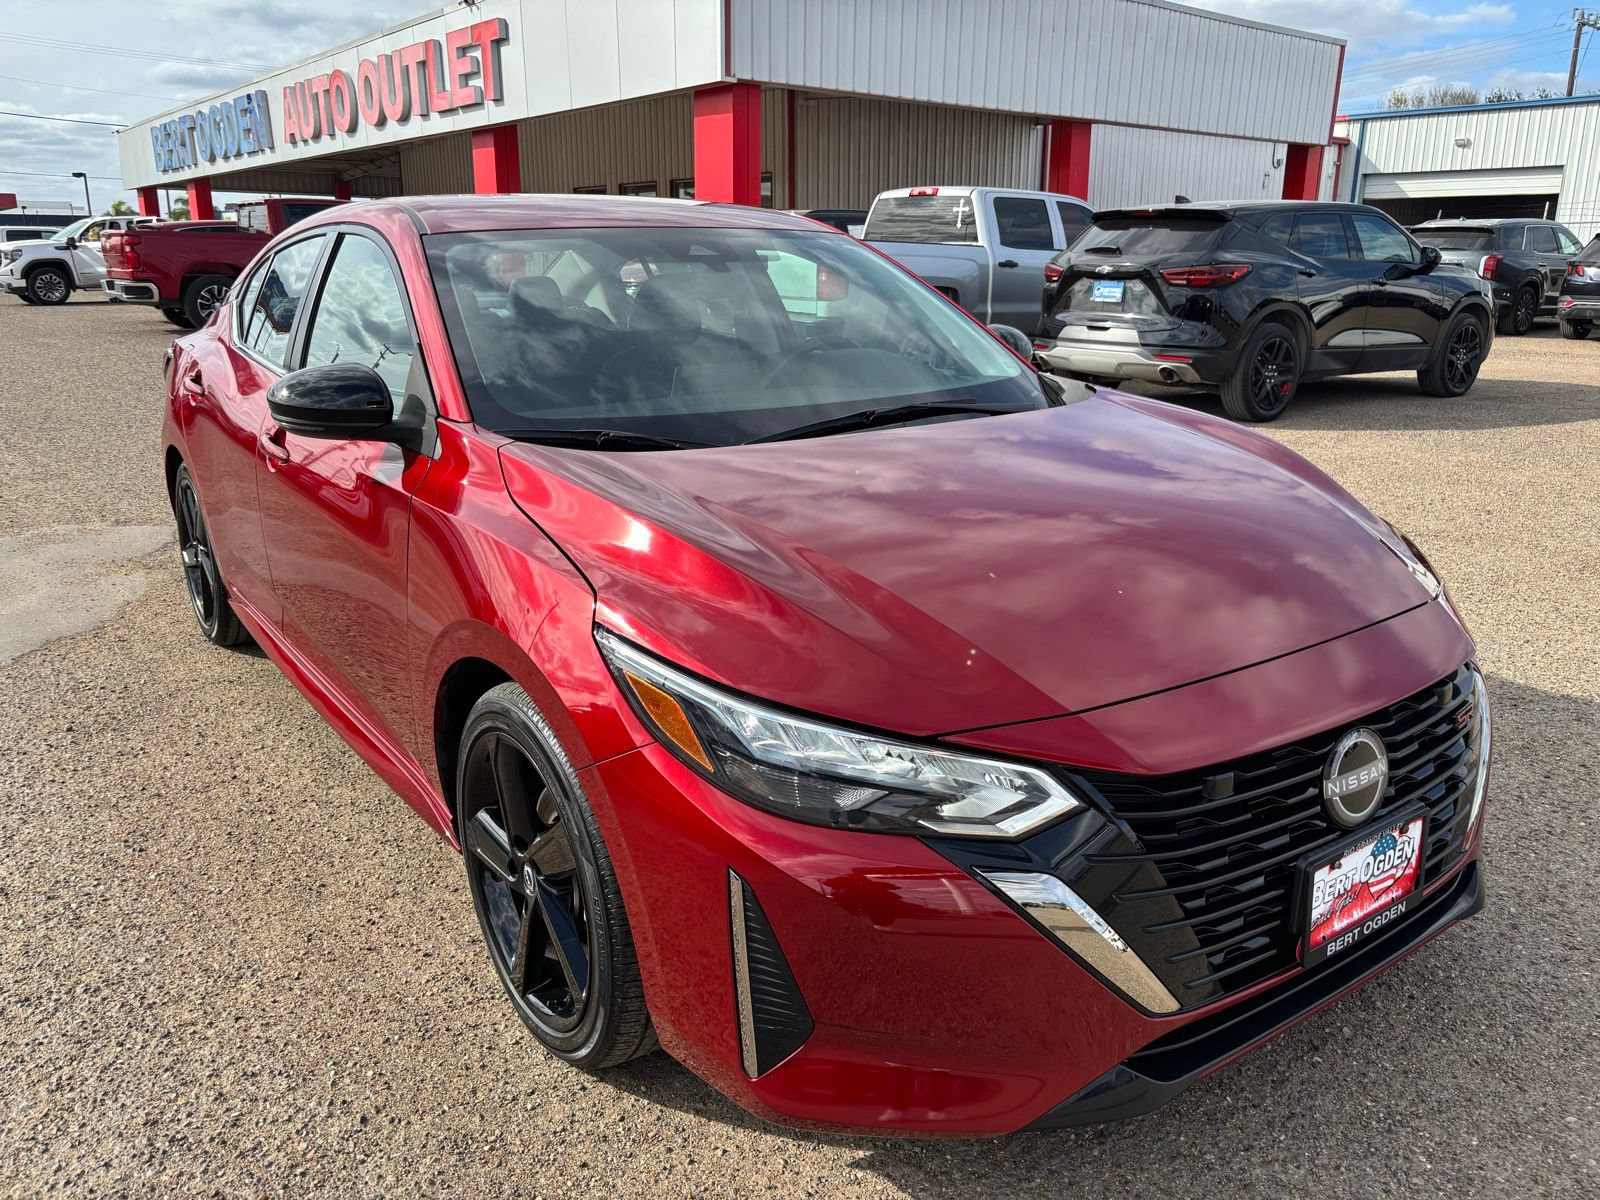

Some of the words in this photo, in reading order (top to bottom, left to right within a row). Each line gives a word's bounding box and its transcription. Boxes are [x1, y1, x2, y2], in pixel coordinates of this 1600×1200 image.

[150, 115, 197, 172] BERT
[196, 90, 272, 162] OGDEN
[283, 69, 356, 143] AUTO
[357, 18, 509, 126] OUTLET
[1327, 758, 1386, 796] NISSAN
[1357, 834, 1381, 851] GRANDE
[1382, 821, 1405, 837] VALLEY
[1312, 867, 1358, 909] BERT
[1360, 837, 1415, 884] OGDEN
[1326, 927, 1360, 957] BERT
[1363, 901, 1406, 935] OGDEN
